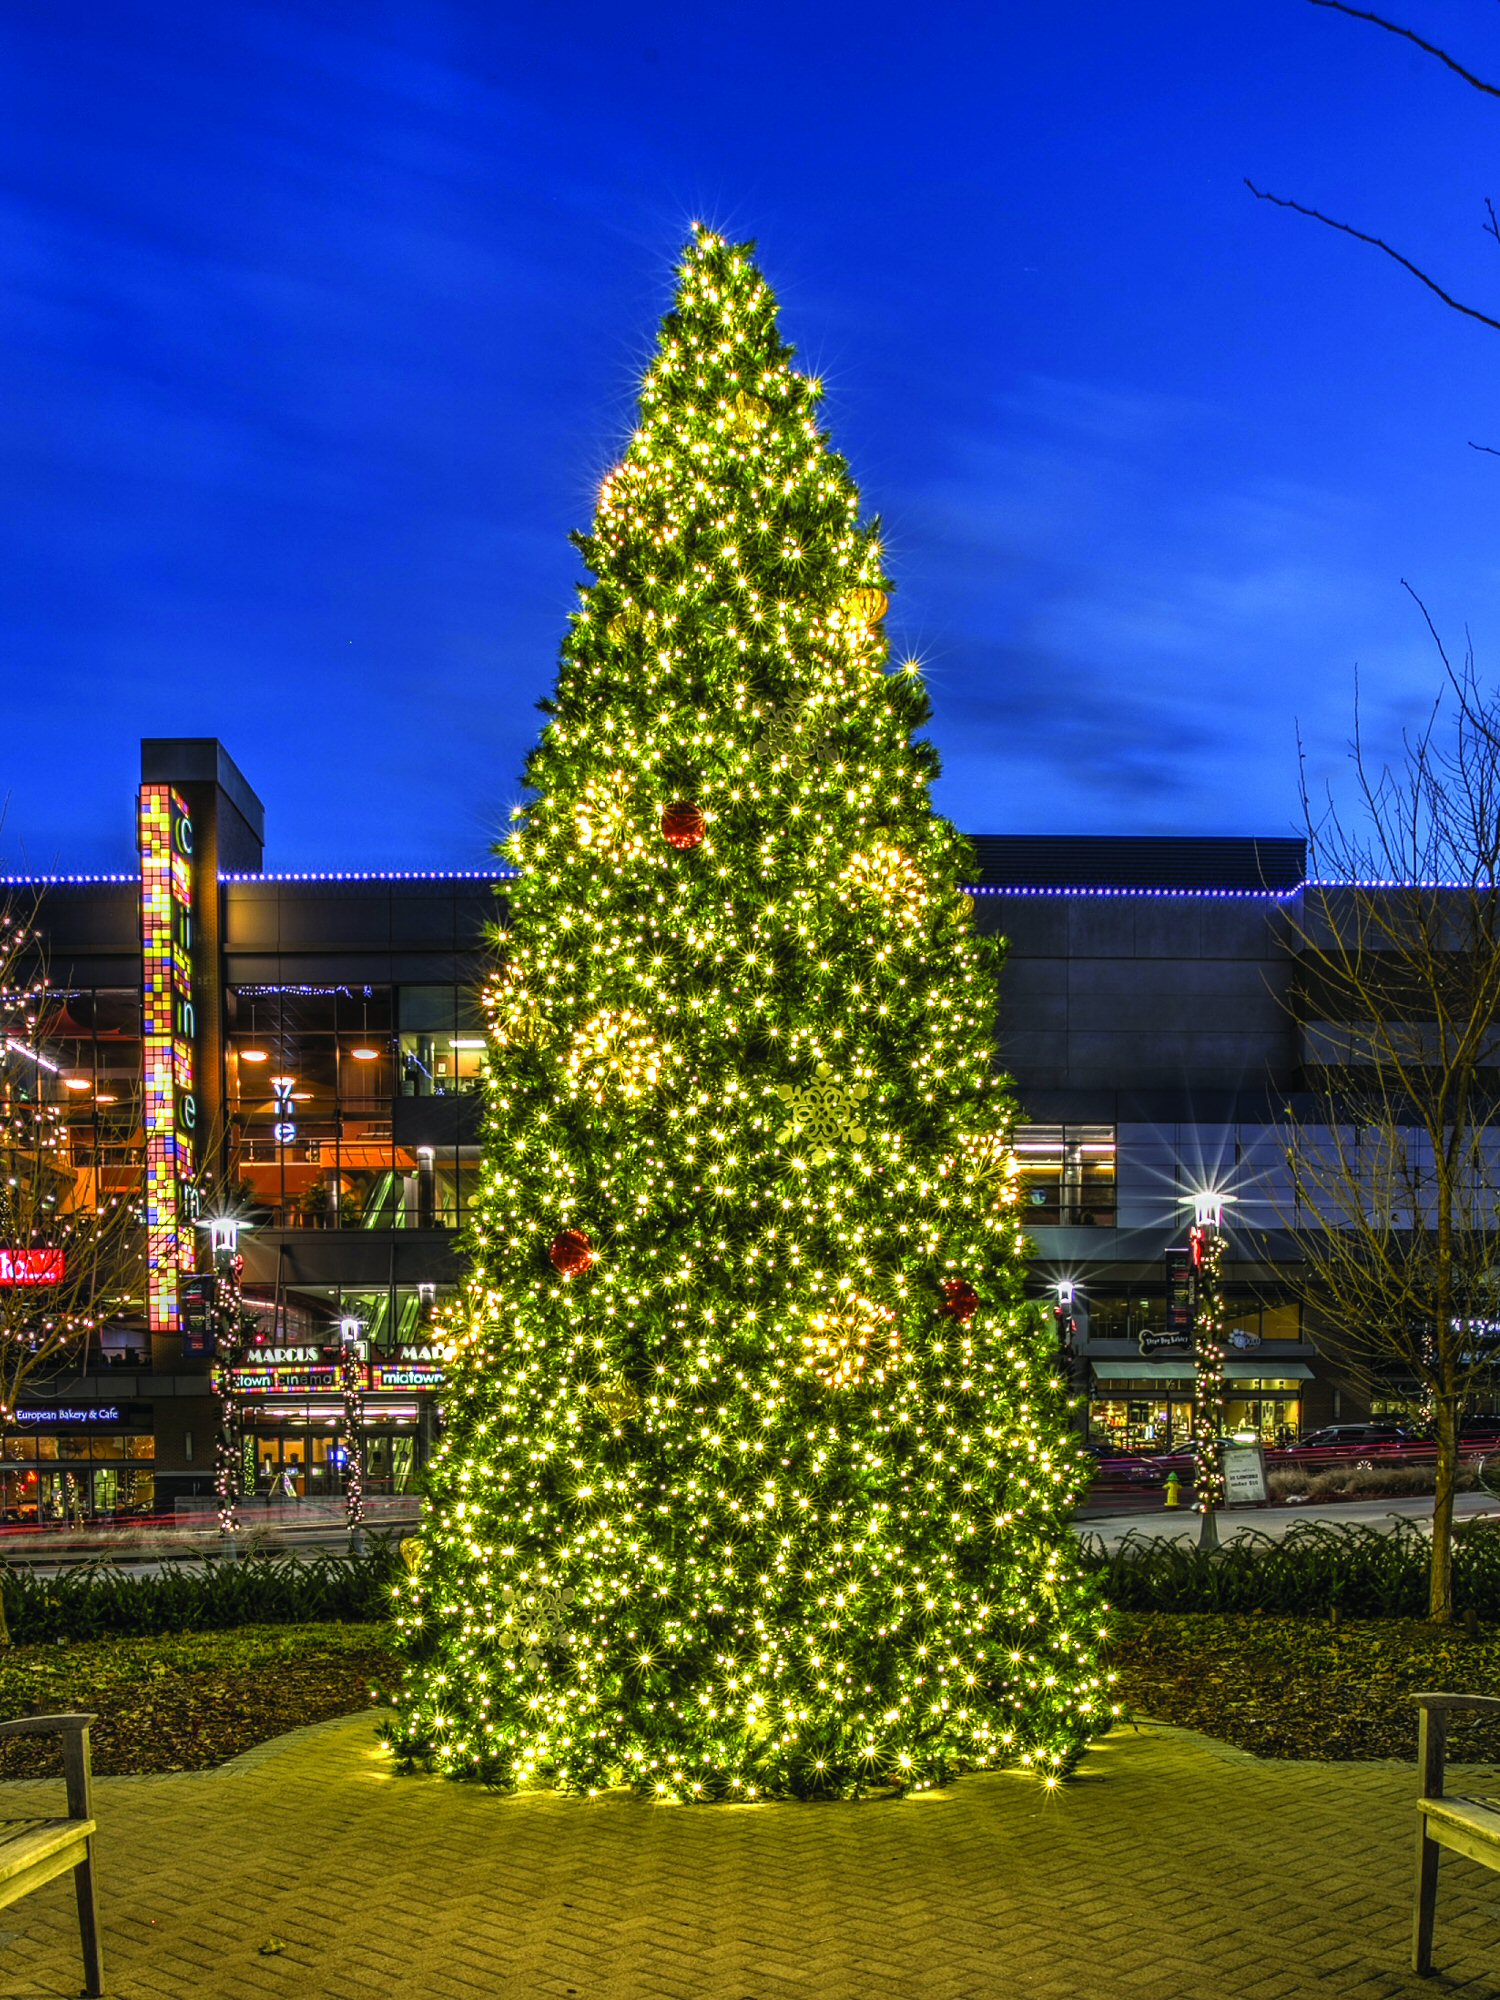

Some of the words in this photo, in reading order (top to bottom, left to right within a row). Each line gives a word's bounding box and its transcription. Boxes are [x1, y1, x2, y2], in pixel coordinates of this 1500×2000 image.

[177, 817, 200, 1218] cinem
[247, 1347, 319, 1362] MARCUS
[278, 1373, 332, 1386] cinema
[383, 1371, 446, 1385] midtown
[16, 1410, 57, 1421] European
[59, 1408, 88, 1422] Bakery
[89, 1410, 98, 1419] &
